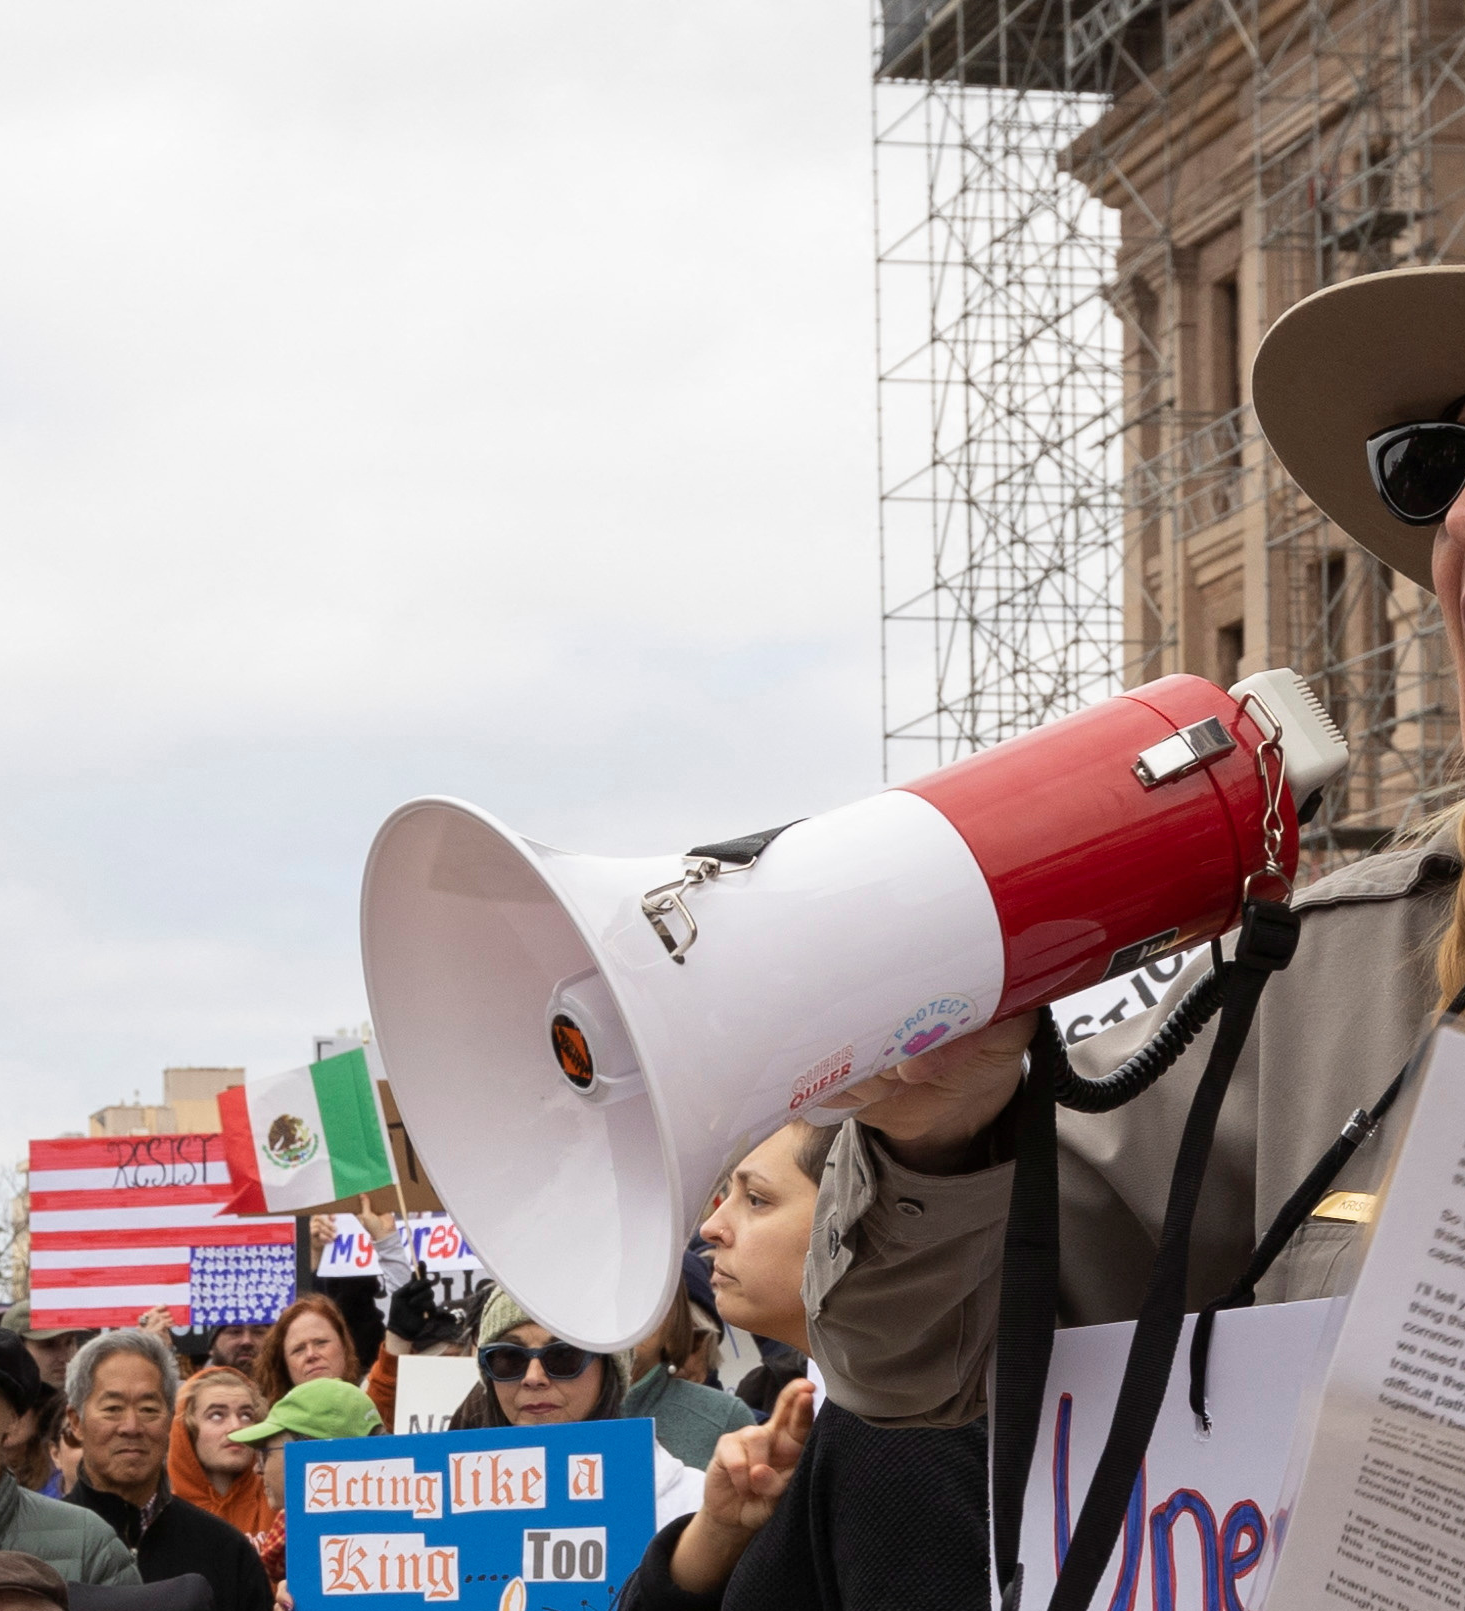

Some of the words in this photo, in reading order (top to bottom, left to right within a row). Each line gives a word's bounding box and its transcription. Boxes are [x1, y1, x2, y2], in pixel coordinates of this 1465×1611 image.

[894, 998, 969, 1041] PROTECT
[107, 1134, 220, 1189] RESIST
[308, 1463, 438, 1514] Acting
[451, 1454, 543, 1507] like
[572, 1457, 600, 1498] a
[527, 1531, 604, 1580] Too
[1367, 1533, 1432, 1566] organized
[1433, 1563, 1460, 1579] and
[1383, 1527, 1433, 1553] enough
[1435, 1548, 1448, 1559] is
[1374, 1550, 1411, 1571] come
[1413, 1566, 1439, 1583] find
[1440, 1580, 1462, 1595] me
[1376, 1565, 1393, 1577] so
[1395, 1573, 1415, 1587] we
[1417, 1584, 1442, 1600] can
[1443, 1594, 1460, 1609] let
[1369, 1590, 1394, 1606] you
